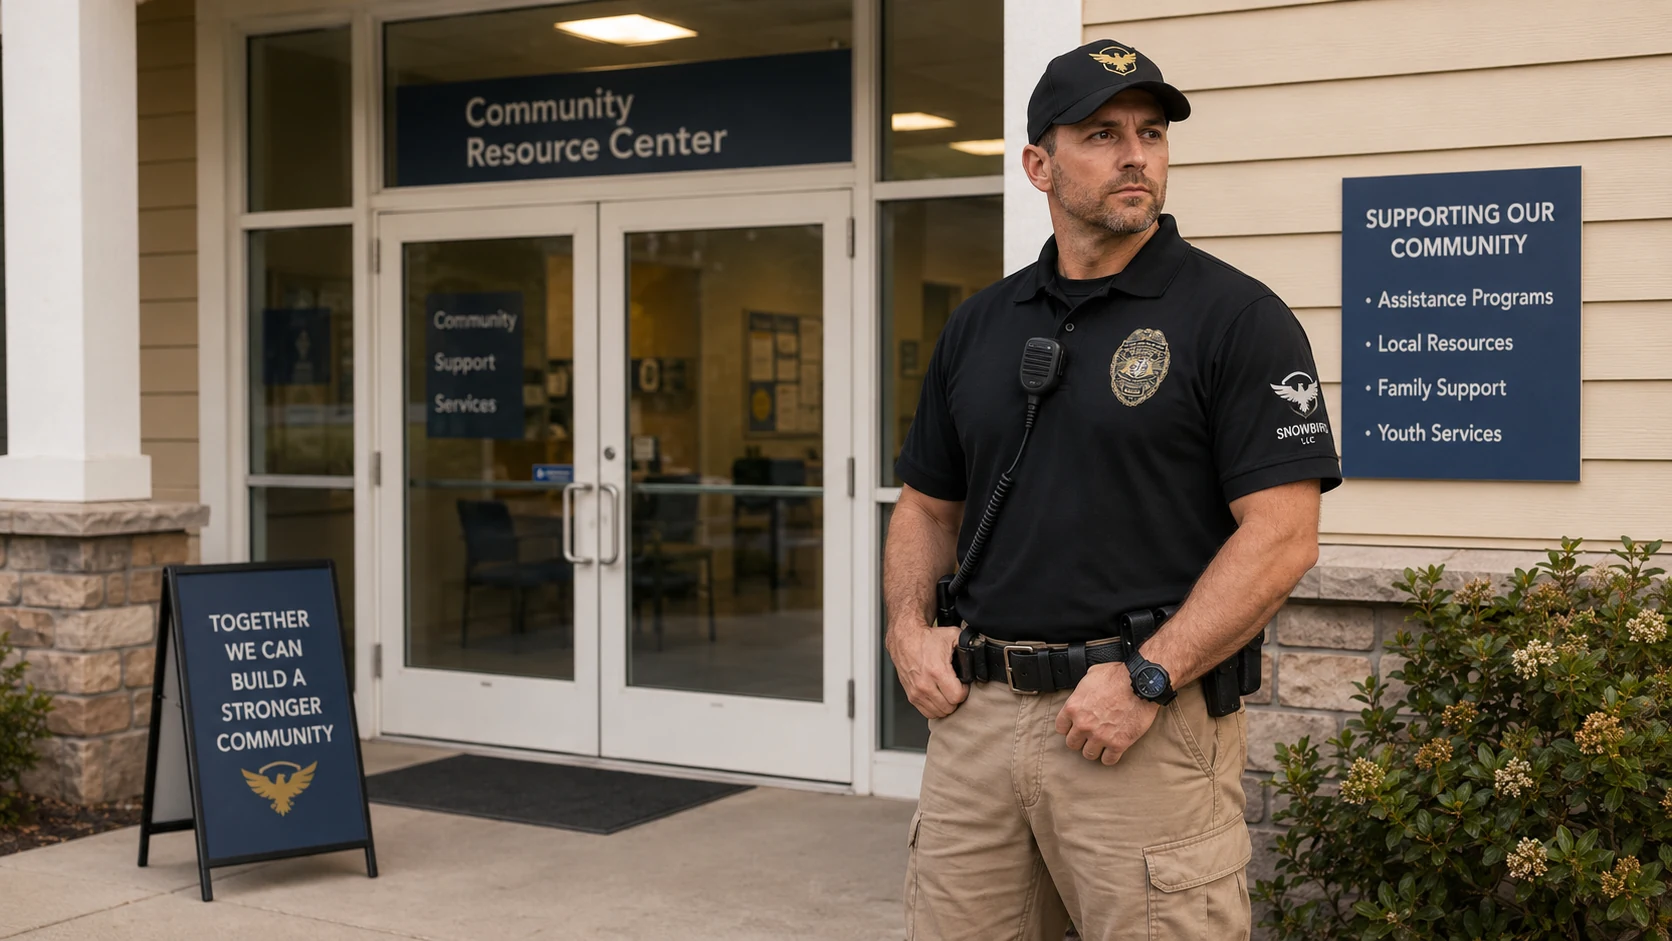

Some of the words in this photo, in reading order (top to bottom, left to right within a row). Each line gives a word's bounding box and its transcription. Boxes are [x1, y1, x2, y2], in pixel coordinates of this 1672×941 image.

[466, 88, 634, 127] Community
[467, 136, 600, 167] Resource
[609, 125, 728, 159] Center
[1365, 203, 1500, 229] SUPPORTING
[1507, 202, 1555, 224] OUR
[1390, 234, 1528, 258] COMMUNITY
[1377, 289, 1467, 309] Assistance
[1472, 288, 1554, 311] Programs
[433, 310, 518, 333] Community
[1378, 333, 1422, 353] Local
[1427, 333, 1514, 352] Resources
[434, 351, 496, 376] Support
[1378, 377, 1432, 402] Family
[1436, 377, 1507, 402] Support
[434, 393, 498, 414] Services
[1377, 422, 1426, 442] Youth
[1431, 423, 1502, 443] Services
[208, 609, 310, 632] TOGETHER
[224, 641, 257, 662] WE
[261, 639, 303, 659] CAN
[230, 669, 287, 691] BUILD
[292, 667, 307, 687] A
[221, 696, 322, 722] STRONGER
[216, 724, 334, 752] COMMUNITY
